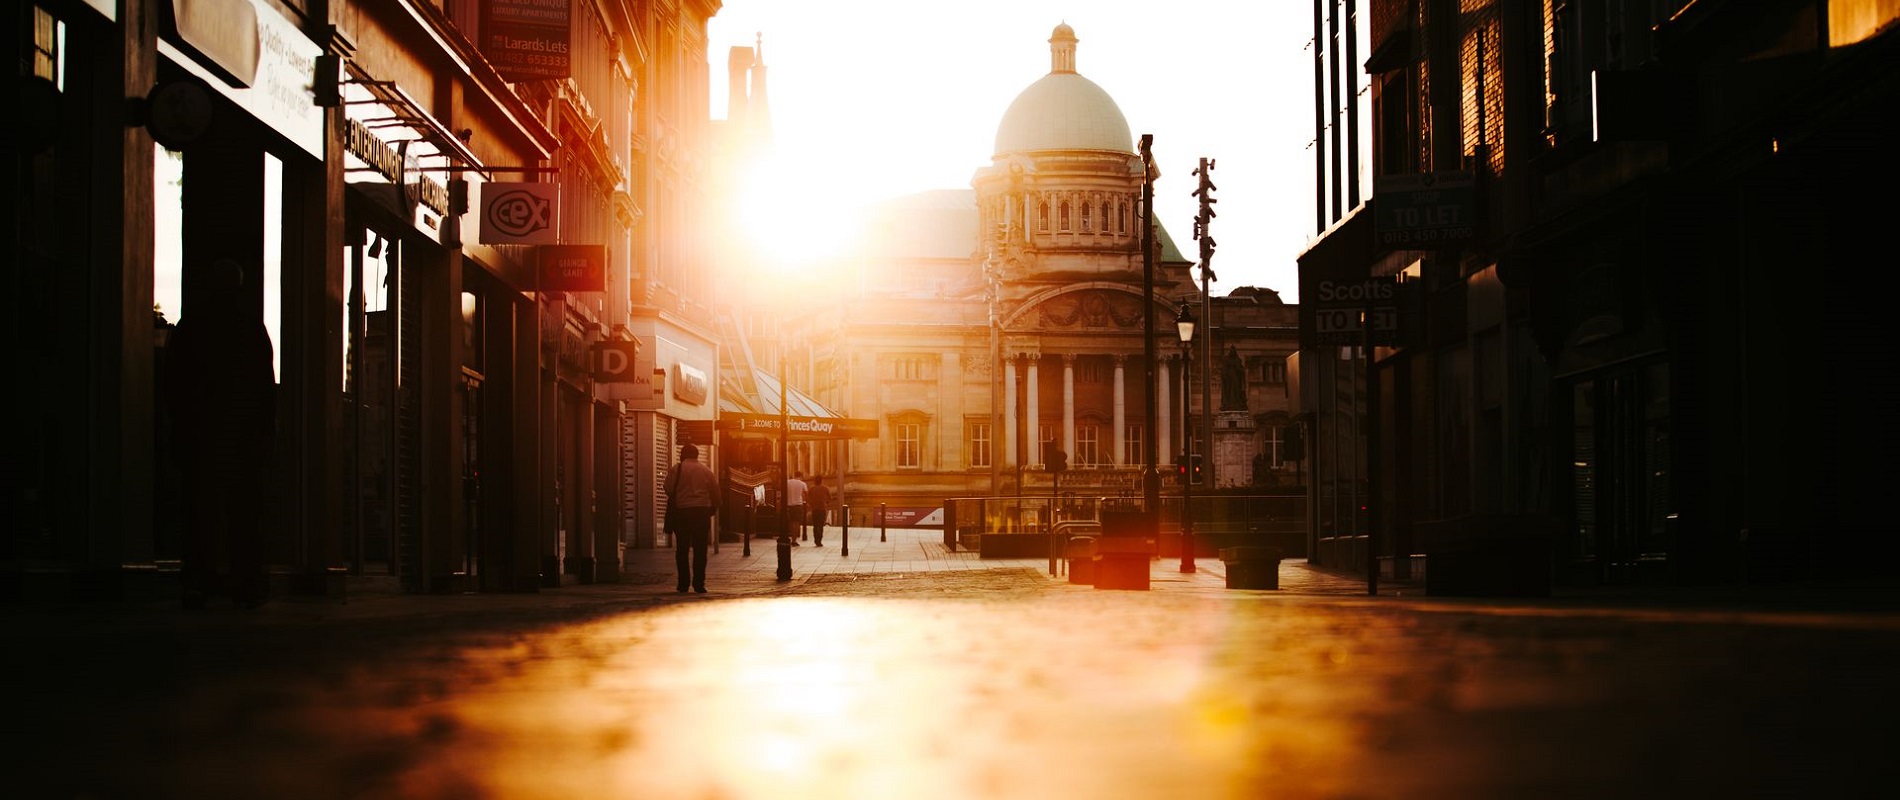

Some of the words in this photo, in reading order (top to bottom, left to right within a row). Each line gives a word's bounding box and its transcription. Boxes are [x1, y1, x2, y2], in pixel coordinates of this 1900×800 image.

[492, 7, 520, 16] LUXURY
[521, 9, 568, 20] APARTMENTS
[505, 36, 545, 51] Larards
[546, 40, 568, 53] Lets
[528, 55, 568, 67] 653333
[350, 117, 403, 187] ENTERTAINMENT
[1393, 207, 1419, 228] TO
[1425, 204, 1462, 226] LET
[1384, 230, 1410, 244] 0113
[1415, 229, 1437, 241] 450
[1319, 280, 1393, 301] Scotts
[1317, 311, 1347, 330] TO
[602, 349, 628, 374] D
[788, 419, 810, 431] rinces
[811, 419, 832, 434] Quay
